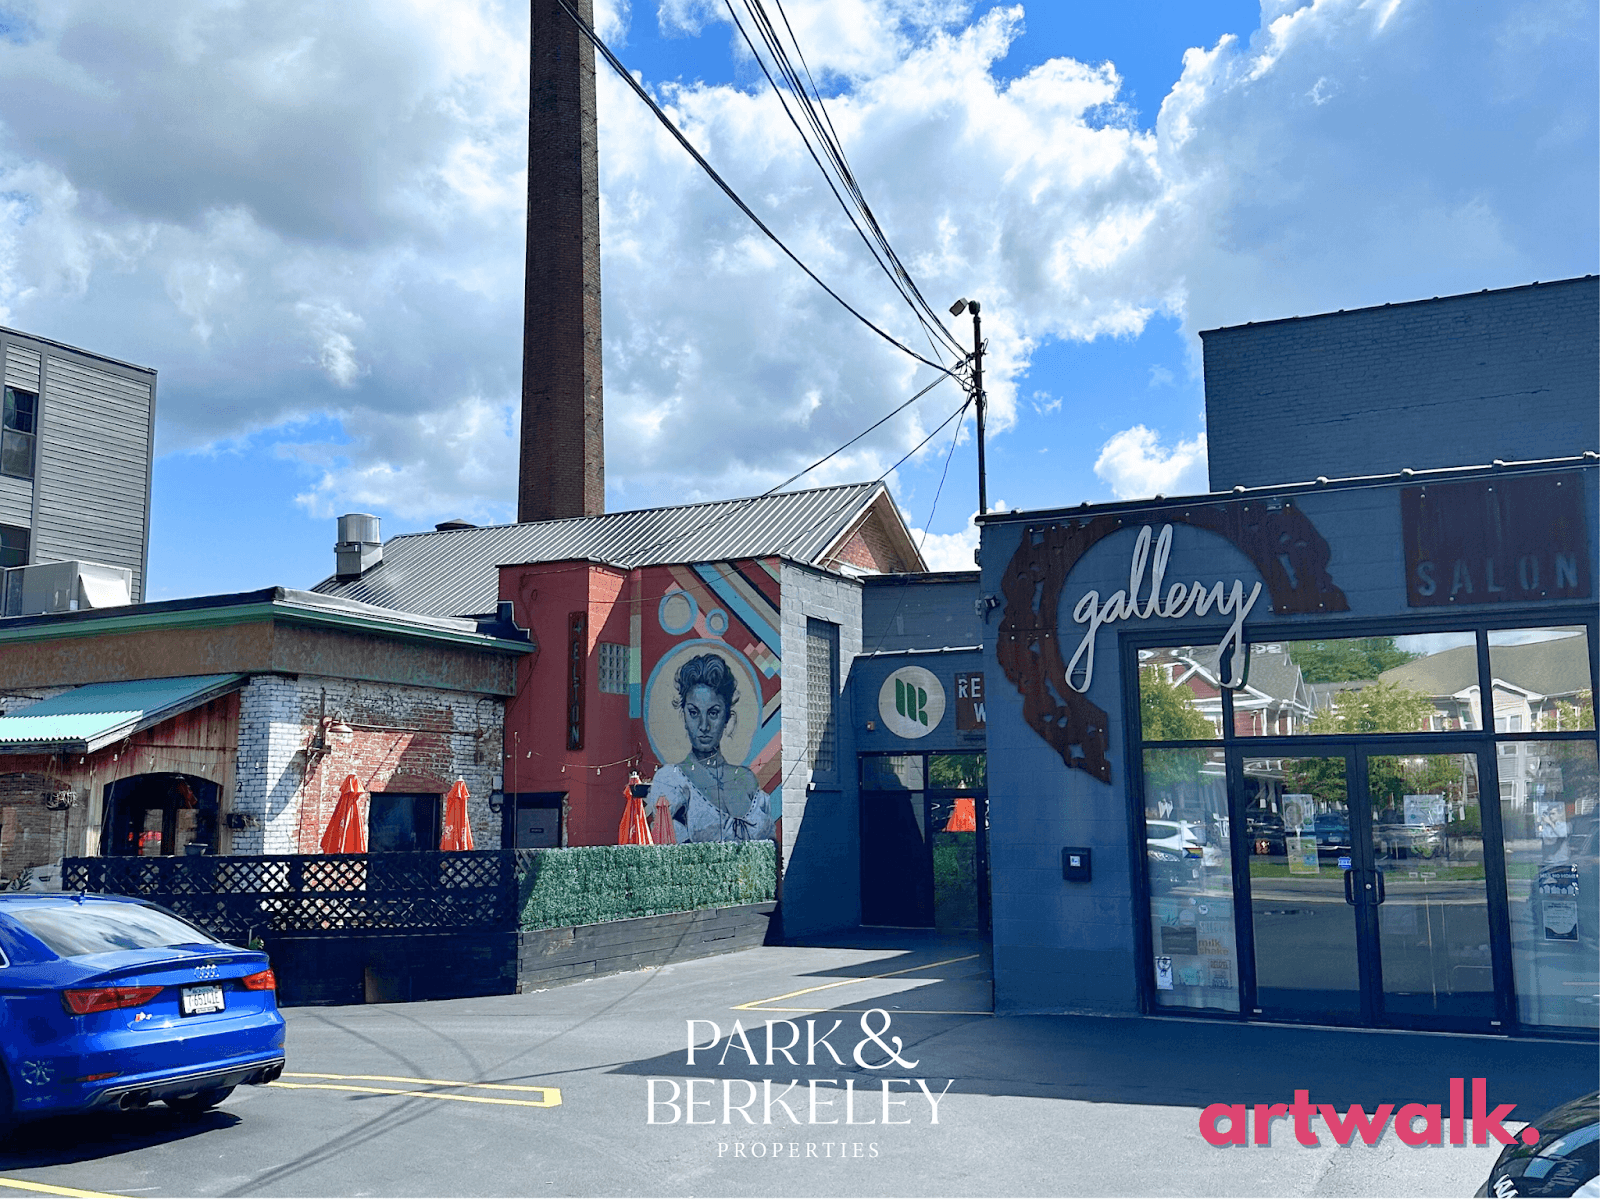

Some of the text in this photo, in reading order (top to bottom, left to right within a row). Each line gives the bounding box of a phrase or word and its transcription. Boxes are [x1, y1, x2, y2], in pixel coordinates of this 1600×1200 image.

[1065, 524, 1262, 692] gallery
[1417, 551, 1579, 597] SALON
[571, 641, 581, 743] ELTON
[1198, 938, 1221, 946] milk
